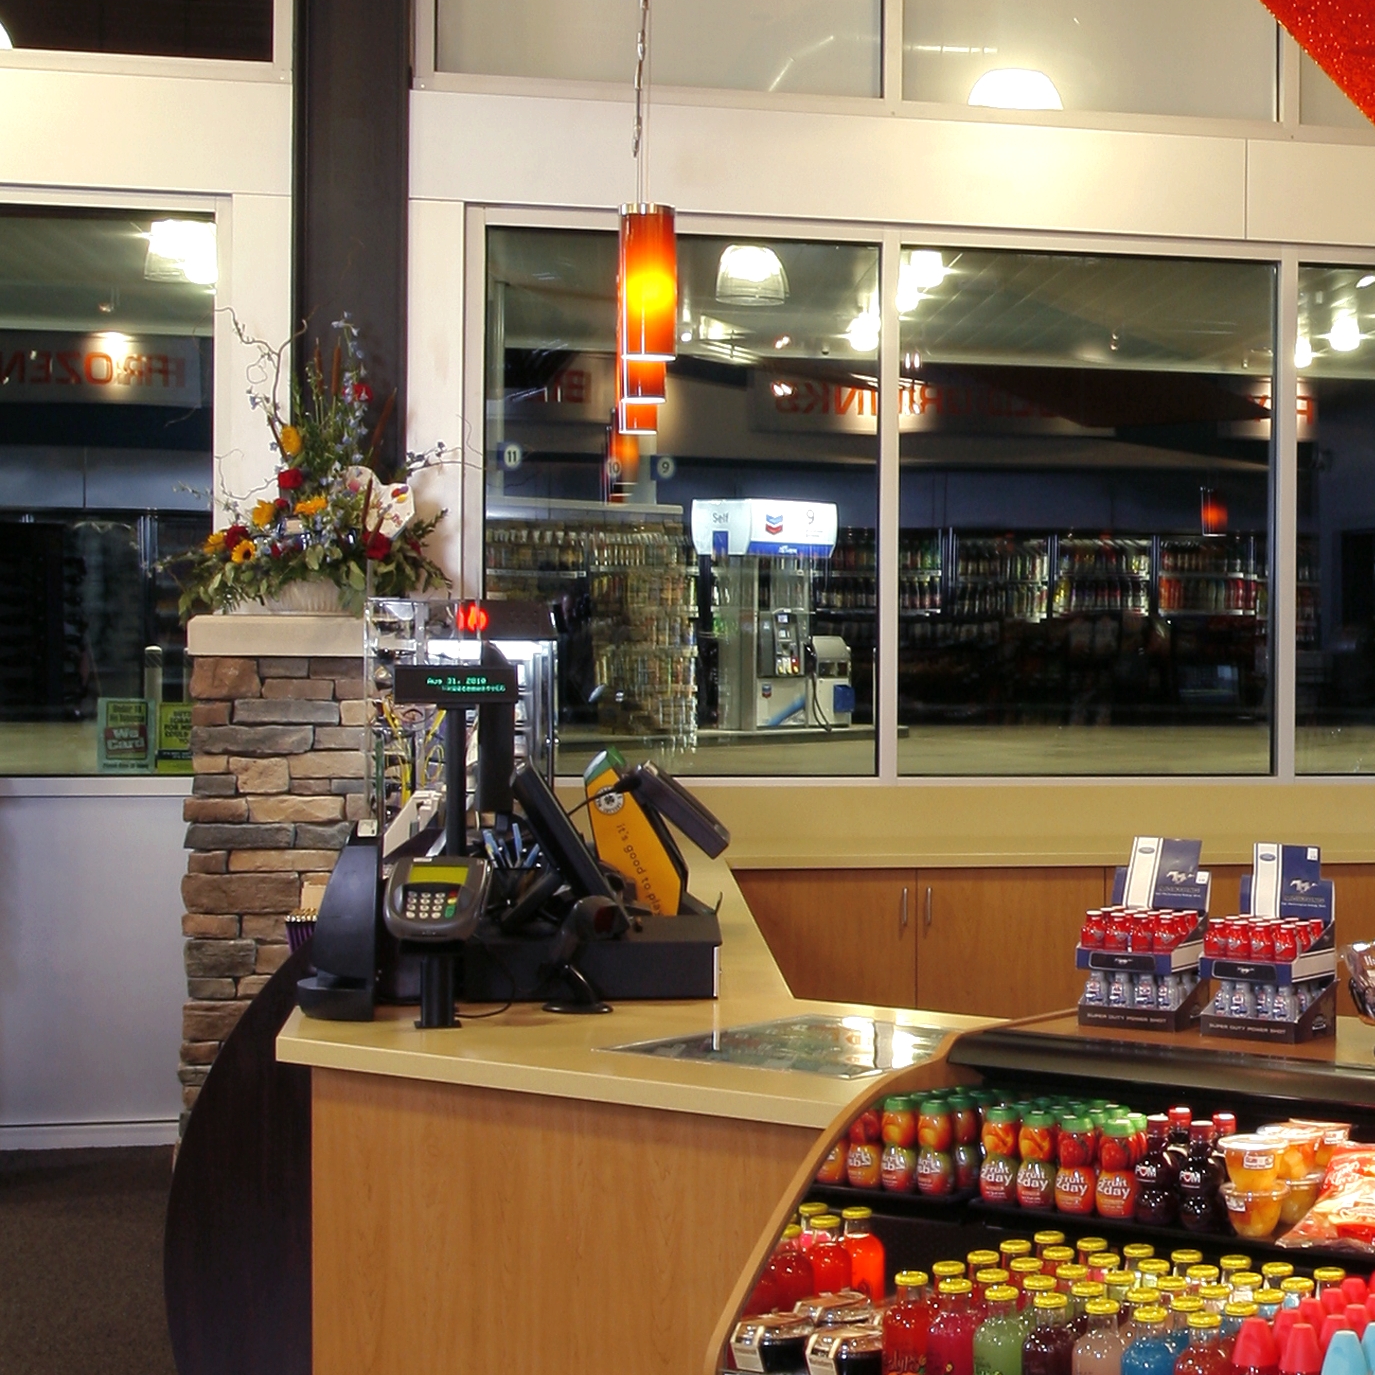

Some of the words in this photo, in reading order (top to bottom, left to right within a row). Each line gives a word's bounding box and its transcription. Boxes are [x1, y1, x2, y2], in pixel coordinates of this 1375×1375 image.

[506, 450, 518, 463] 11
[660, 461, 670, 474] 9
[712, 511, 729, 524] Self
[806, 509, 815, 525] 9
[113, 728, 139, 739] We
[106, 737, 146, 751] Card
[616, 822, 629, 842] it's
[623, 845, 646, 875] good
[641, 878, 651, 890] to
[1135, 1163, 1156, 1177] POM
[1179, 1169, 1201, 1184] POM
[1060, 1172, 1085, 1185] Fruit
[1101, 1177, 1127, 1189] Fruit
[1056, 1178, 1088, 1196] 2day
[1097, 1182, 1131, 1199] 2day
